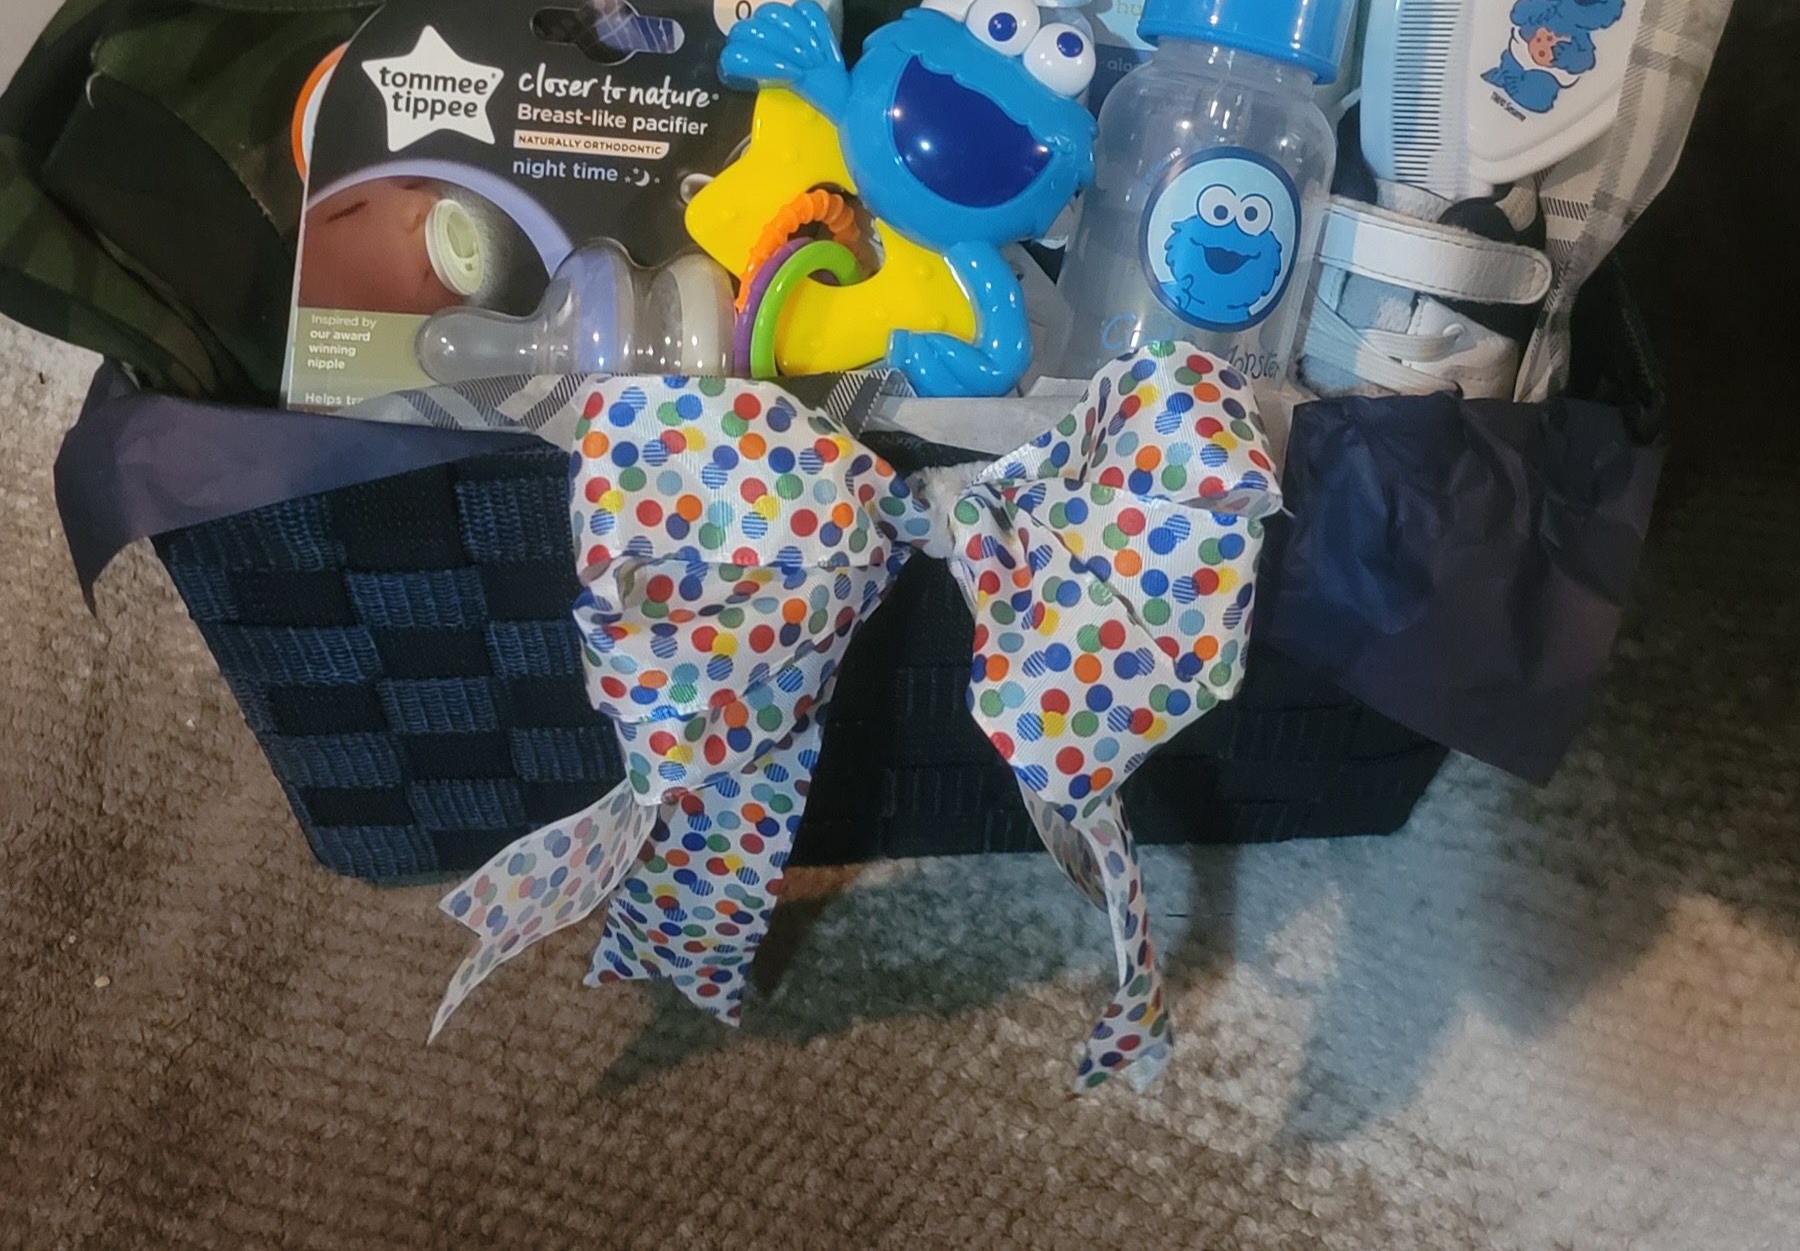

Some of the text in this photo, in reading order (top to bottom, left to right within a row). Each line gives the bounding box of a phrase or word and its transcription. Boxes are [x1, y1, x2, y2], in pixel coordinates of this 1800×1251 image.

[379, 66, 488, 95] tommee
[518, 62, 711, 110] closer to nature
[392, 90, 478, 121] tippee
[517, 102, 709, 136] Breast-like pacifier
[518, 134, 663, 156] NATURALLY ORTHODONTIC
[512, 157, 619, 182] night time
[311, 314, 377, 330] Inspired by
[309, 329, 371, 342] our award
[308, 343, 357, 357] winning
[307, 358, 346, 370] nipple
[304, 392, 342, 406] Helps
